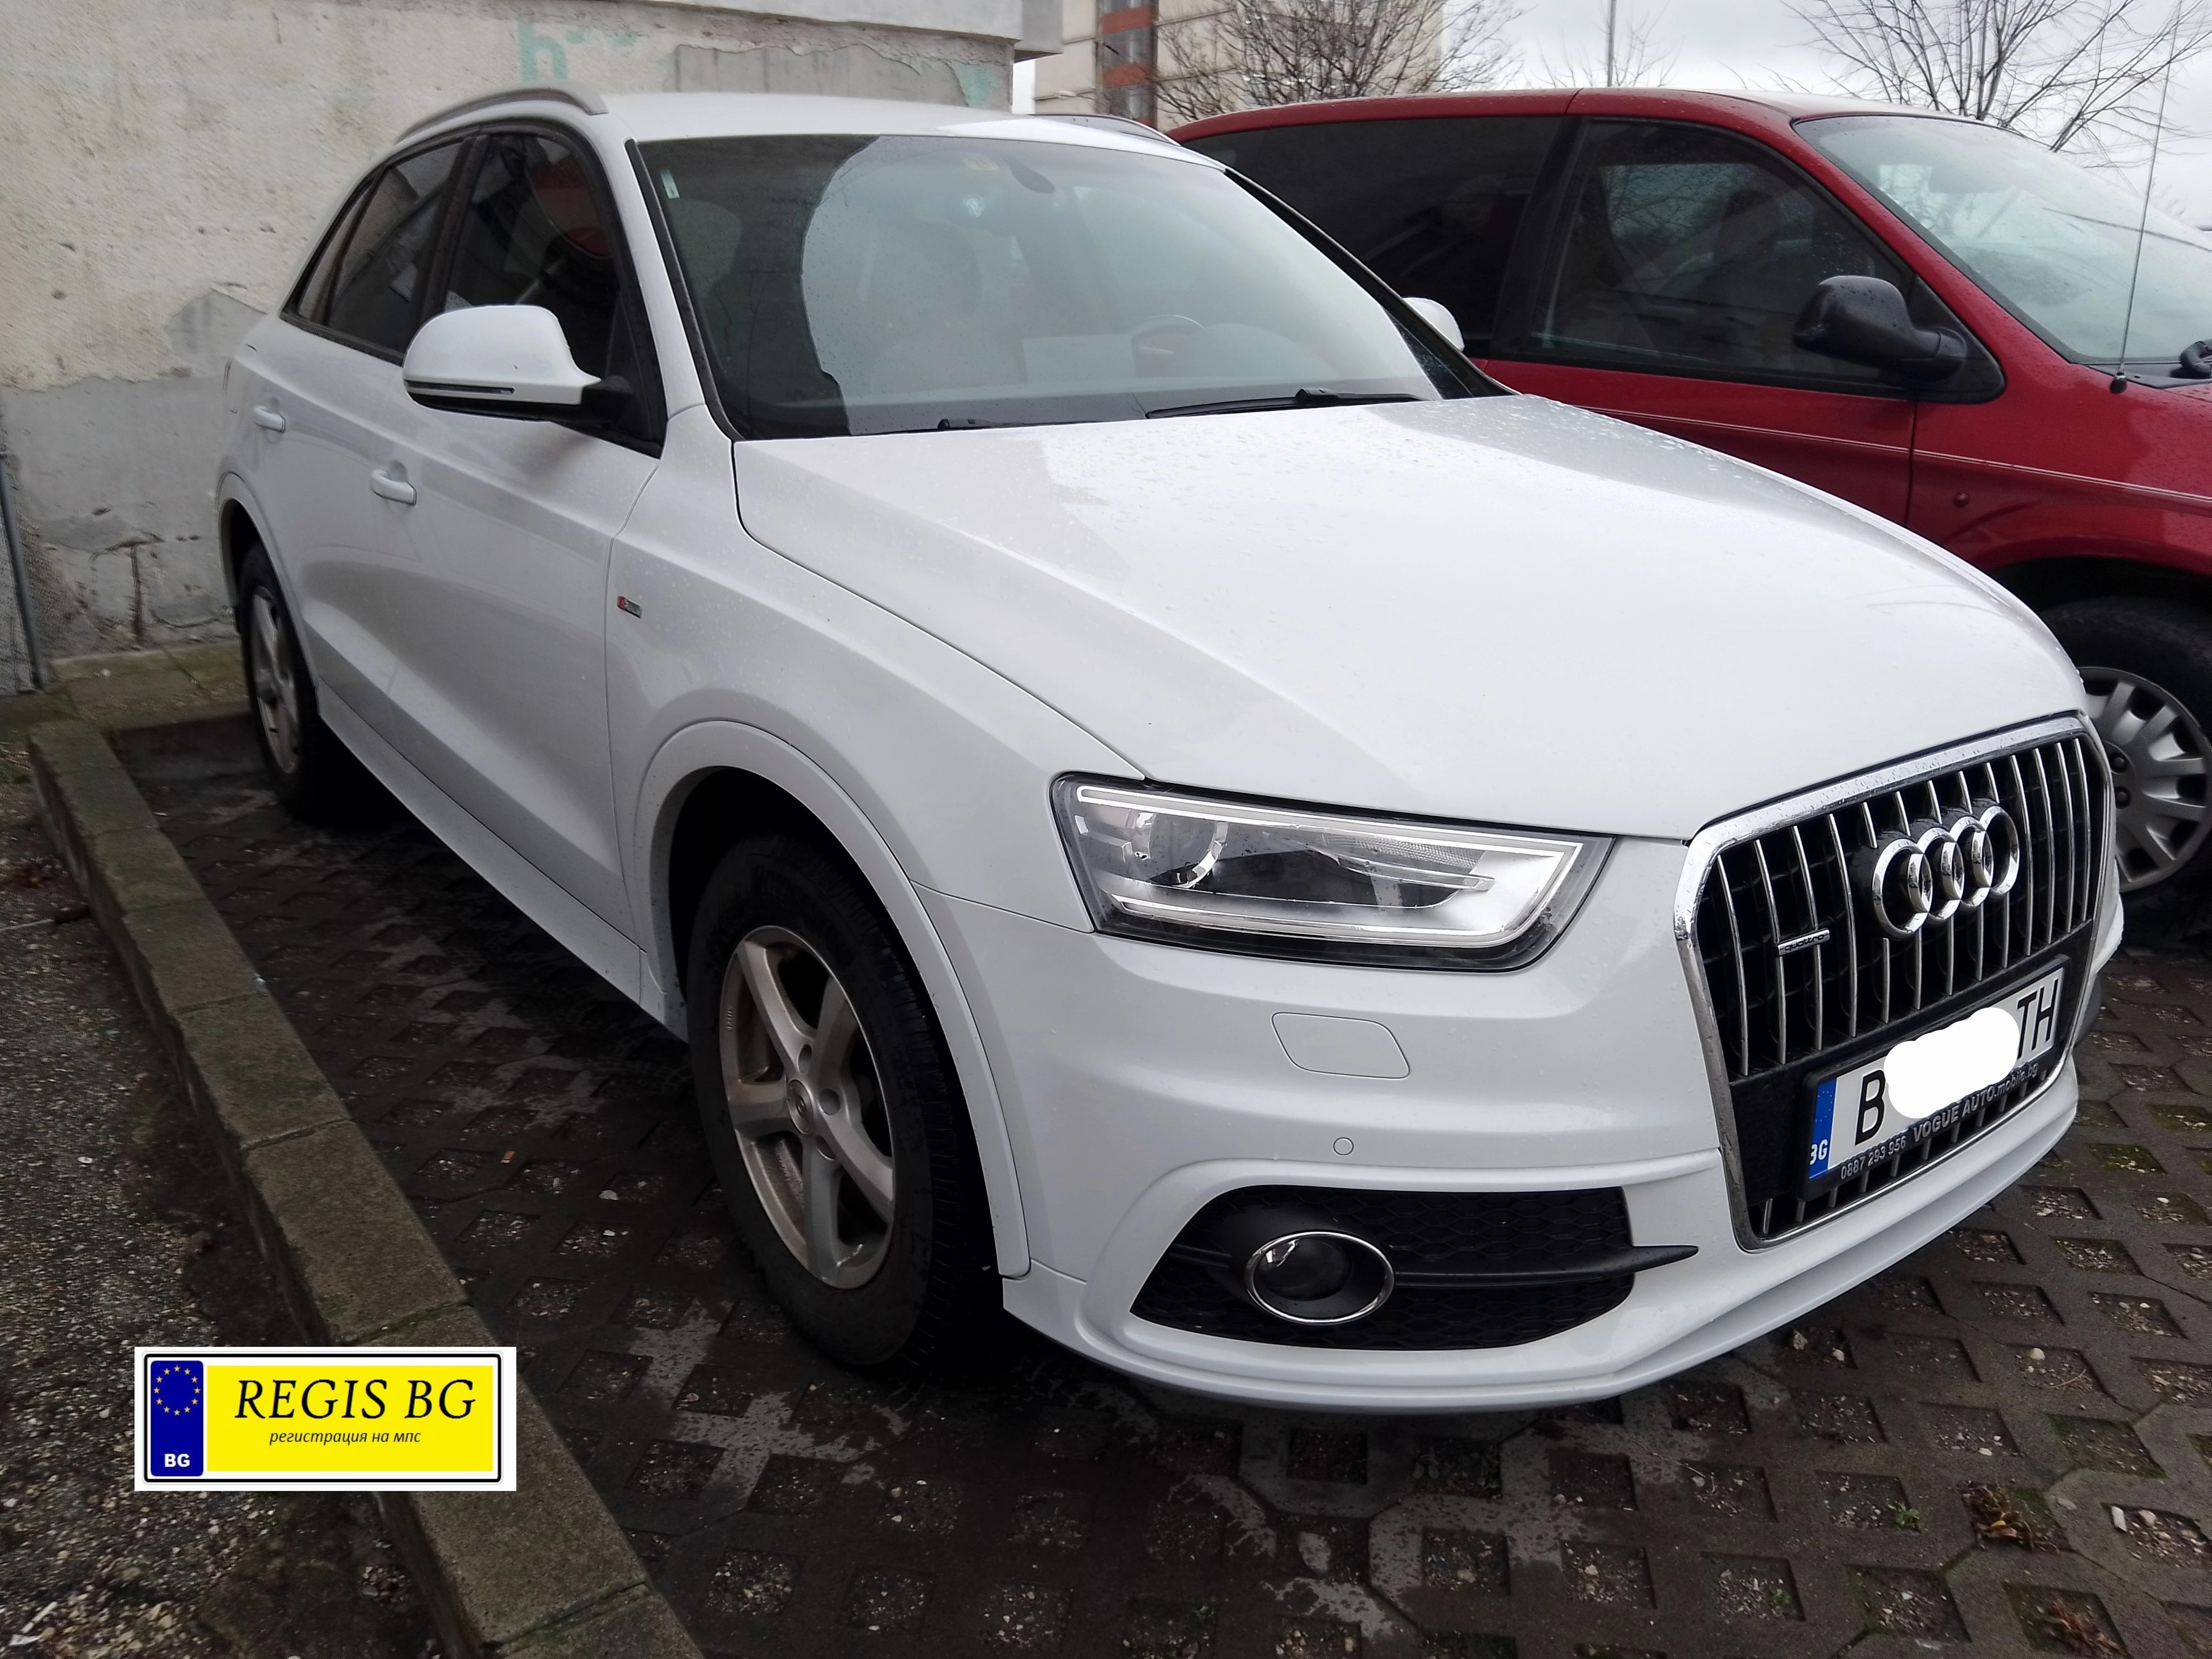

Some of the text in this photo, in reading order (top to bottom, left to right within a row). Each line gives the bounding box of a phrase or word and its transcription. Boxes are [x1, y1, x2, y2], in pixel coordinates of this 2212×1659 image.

[1784, 934, 1824, 951] quattro
[1855, 978, 2059, 1146] B TH
[1841, 1155, 1866, 1180] 0887
[1867, 1146, 1886, 1167] 293
[1888, 1135, 1906, 1155] 956
[1913, 1104, 1959, 1143] VOGUE
